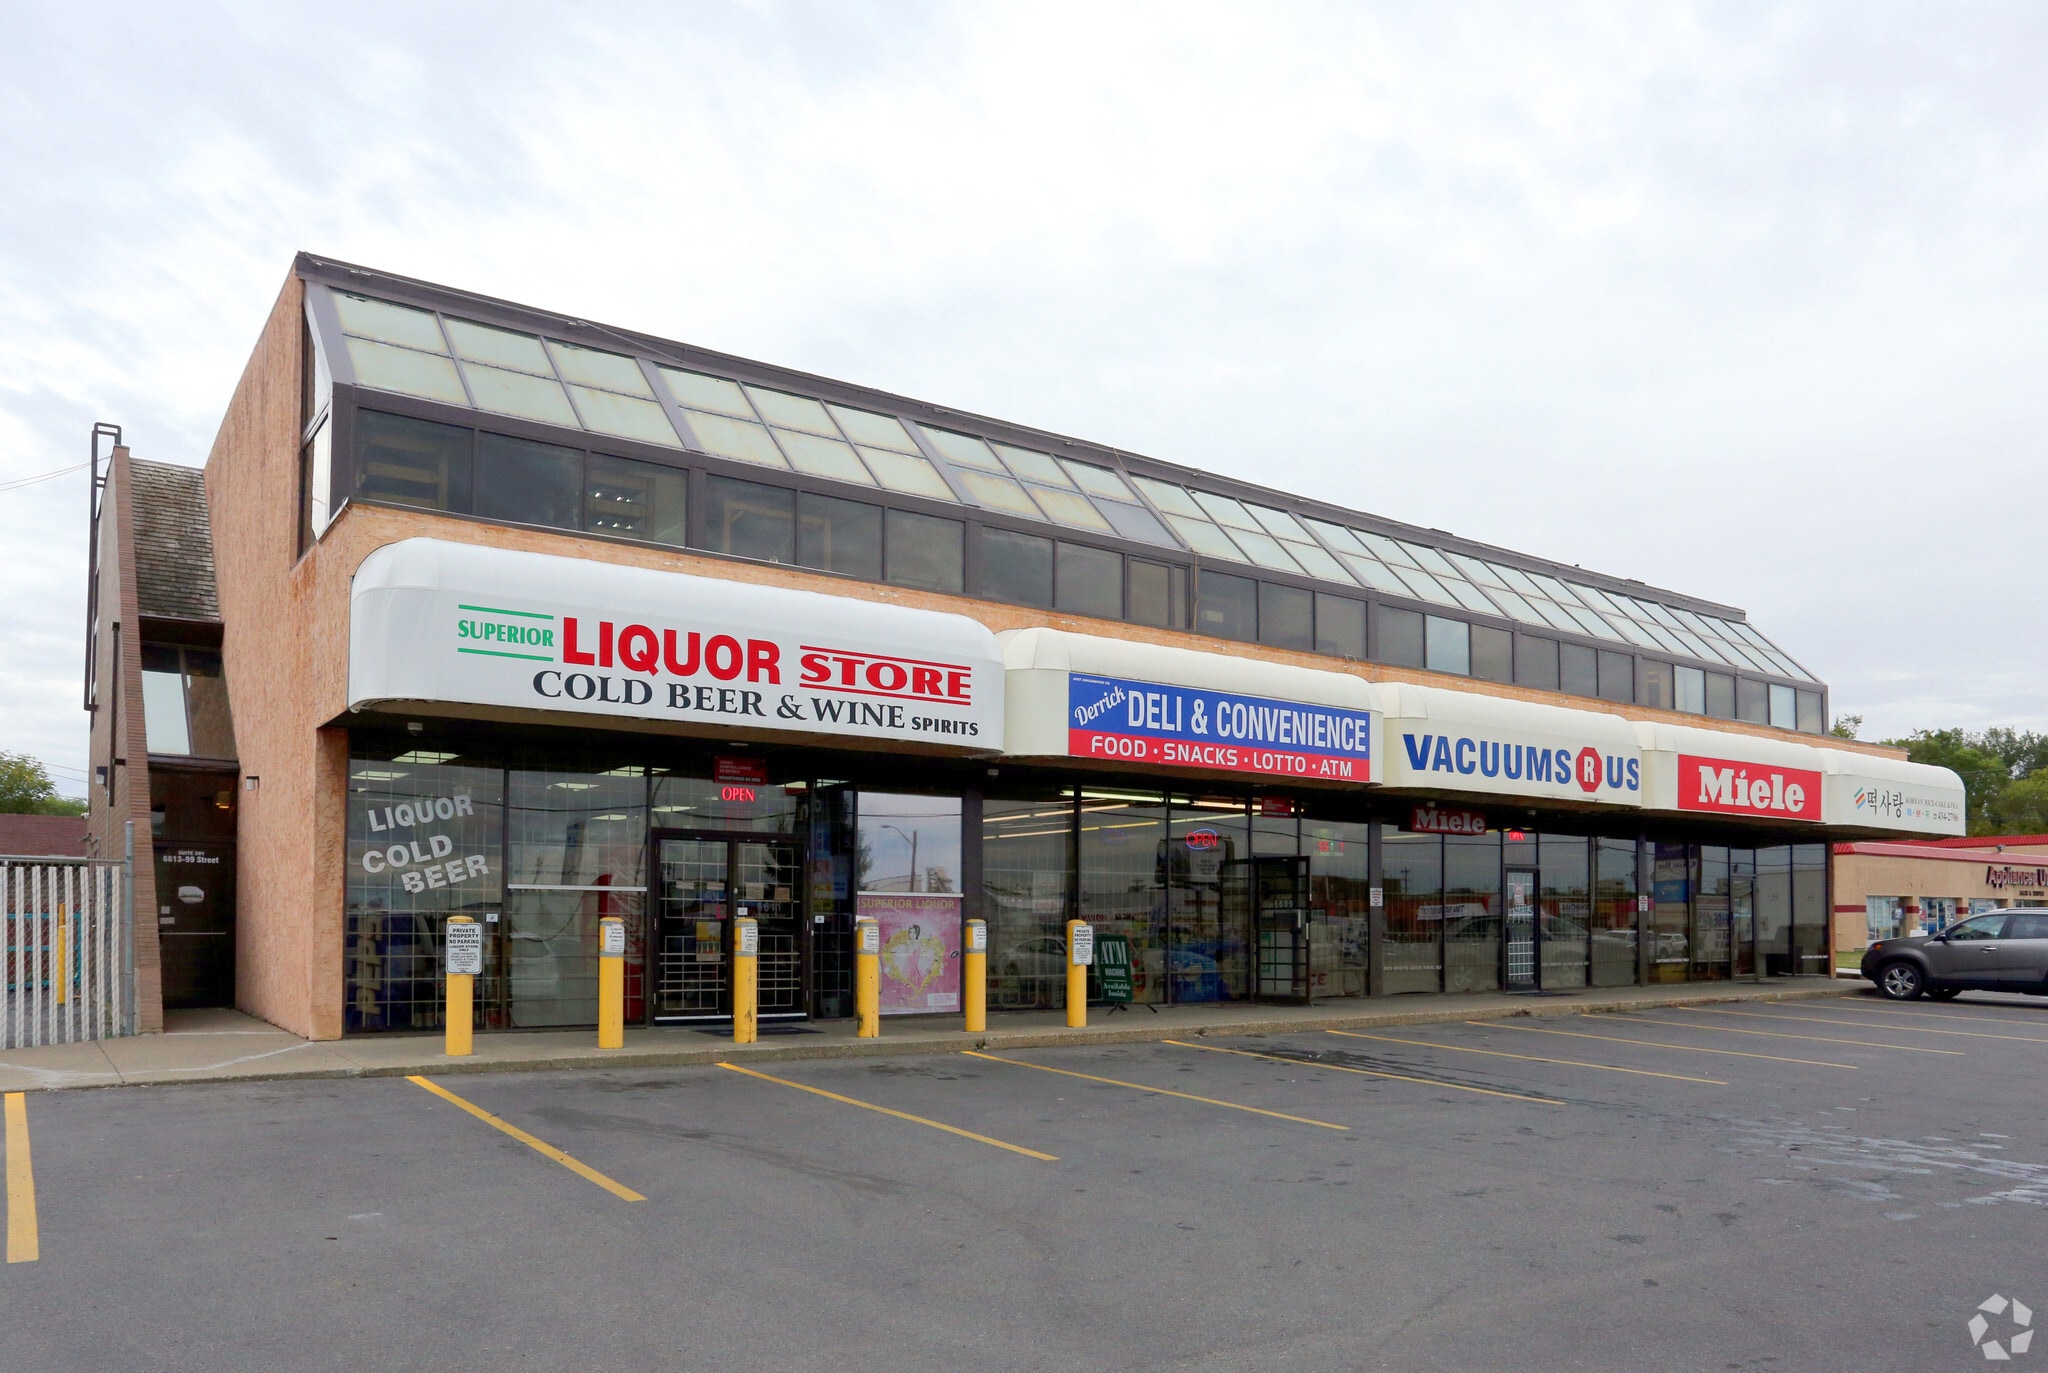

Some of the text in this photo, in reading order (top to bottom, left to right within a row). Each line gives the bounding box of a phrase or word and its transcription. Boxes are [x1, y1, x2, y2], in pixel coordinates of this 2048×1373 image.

[458, 619, 553, 648] SUPERIOR
[562, 617, 781, 685] LIQUOR
[800, 654, 971, 699] STORE
[532, 670, 979, 737] COLD BEER & WINE SPIRITS
[1074, 685, 1126, 726] Derrick
[1127, 689, 1367, 752] DELI & CONVENIENCE
[1091, 735, 1352, 778] FOOD SNACKS LOTTO ATM
[1402, 733, 1639, 791] VACUUMS R US
[721, 786, 755, 802] OPEN
[1698, 765, 1805, 813] Miele
[1867, 788, 1903, 818] 떡사랑
[367, 794, 474, 832] LIQUOR
[1414, 808, 1485, 833] Miele
[1185, 832, 1217, 847] OPEN
[1508, 830, 1525, 841] OPEN
[196, 856, 219, 864] Street
[362, 834, 453, 874] COLD
[401, 854, 490, 895] BEER
[1986, 866, 2037, 888] Appliances
[861, 898, 955, 910] SUPERIOR LIQUOR
[1100, 941, 1128, 965] ATM
[1103, 982, 1131, 990] Available
[1108, 989, 1127, 998] Inside
